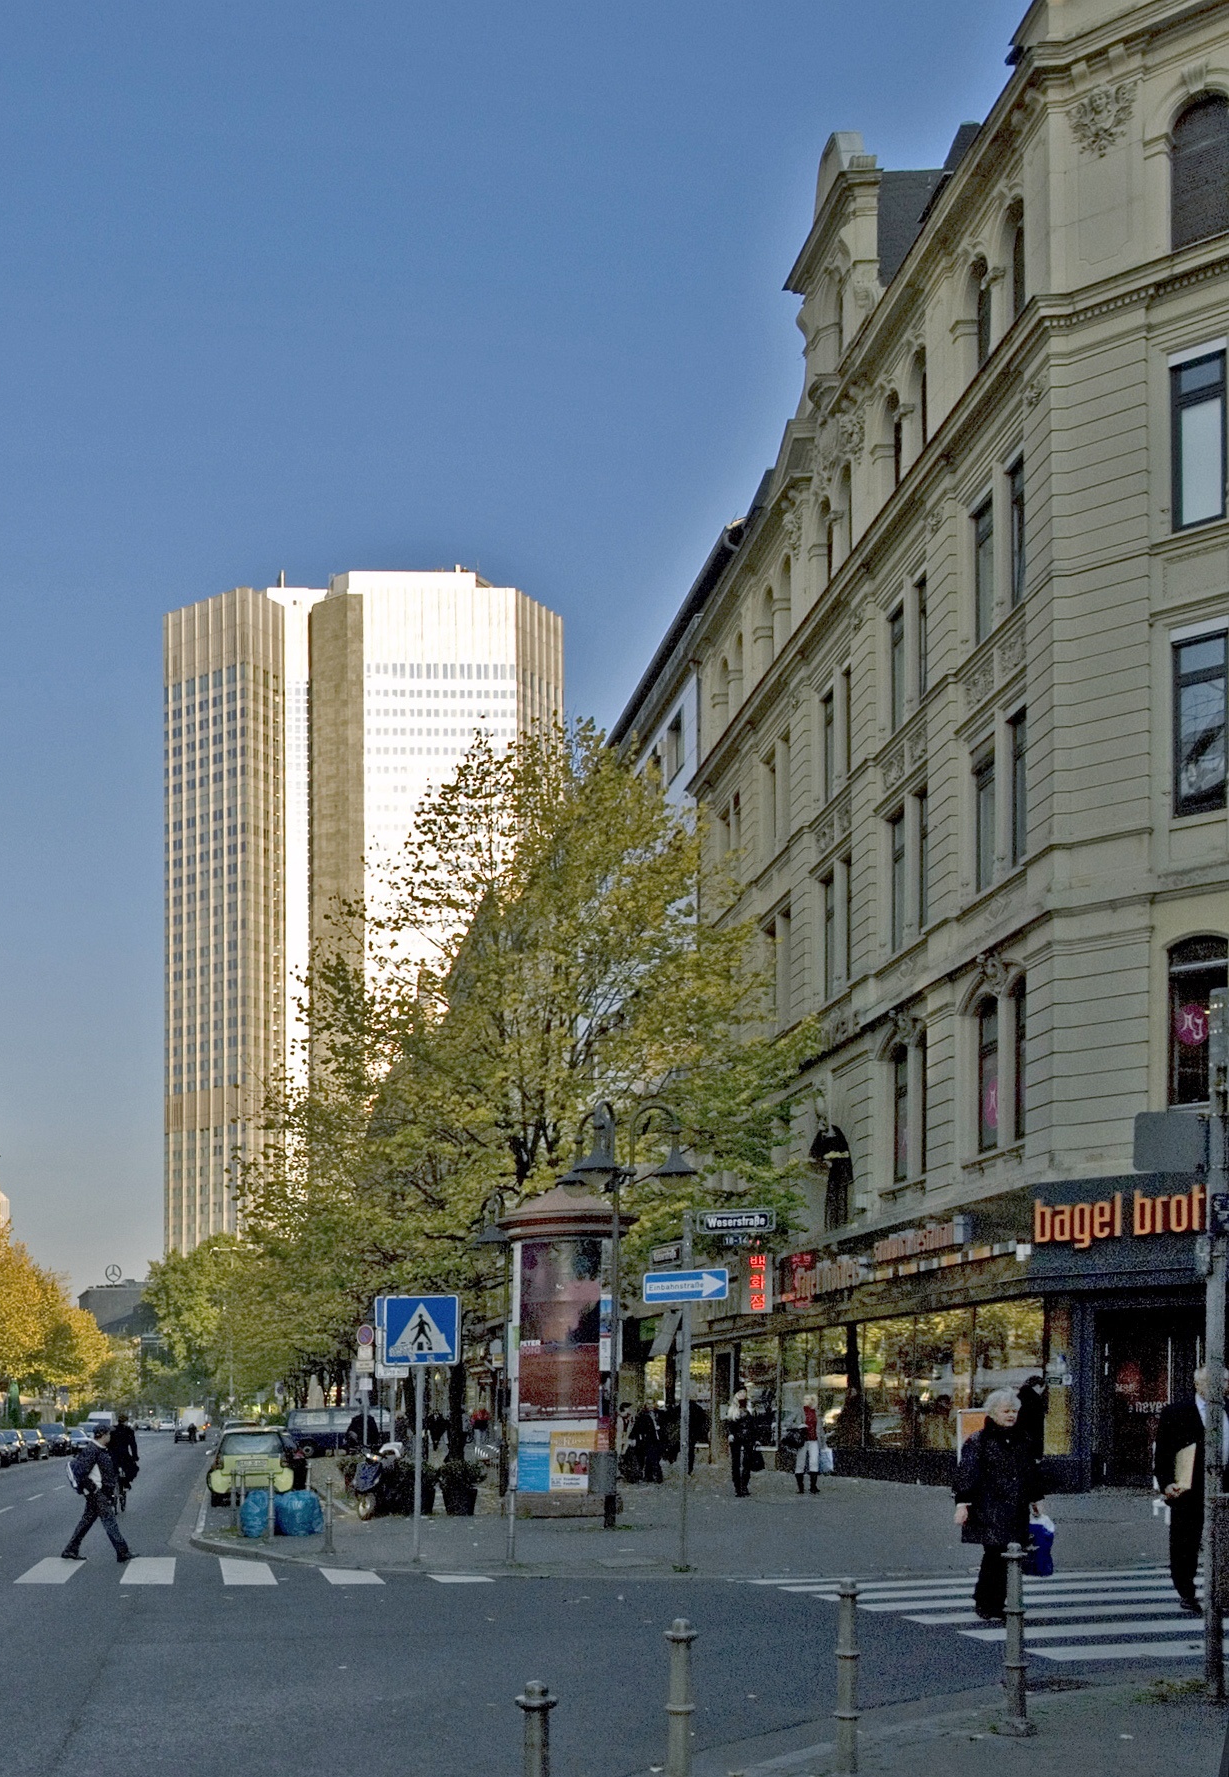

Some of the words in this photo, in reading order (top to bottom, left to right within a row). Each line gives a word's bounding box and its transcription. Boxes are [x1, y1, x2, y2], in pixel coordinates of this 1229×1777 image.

[706, 1215, 766, 1229] Weserstraße
[1034, 1191, 1122, 1249] bagel
[1133, 1184, 1205, 1236] brot
[648, 1281, 704, 1292] Einbahnstraße
